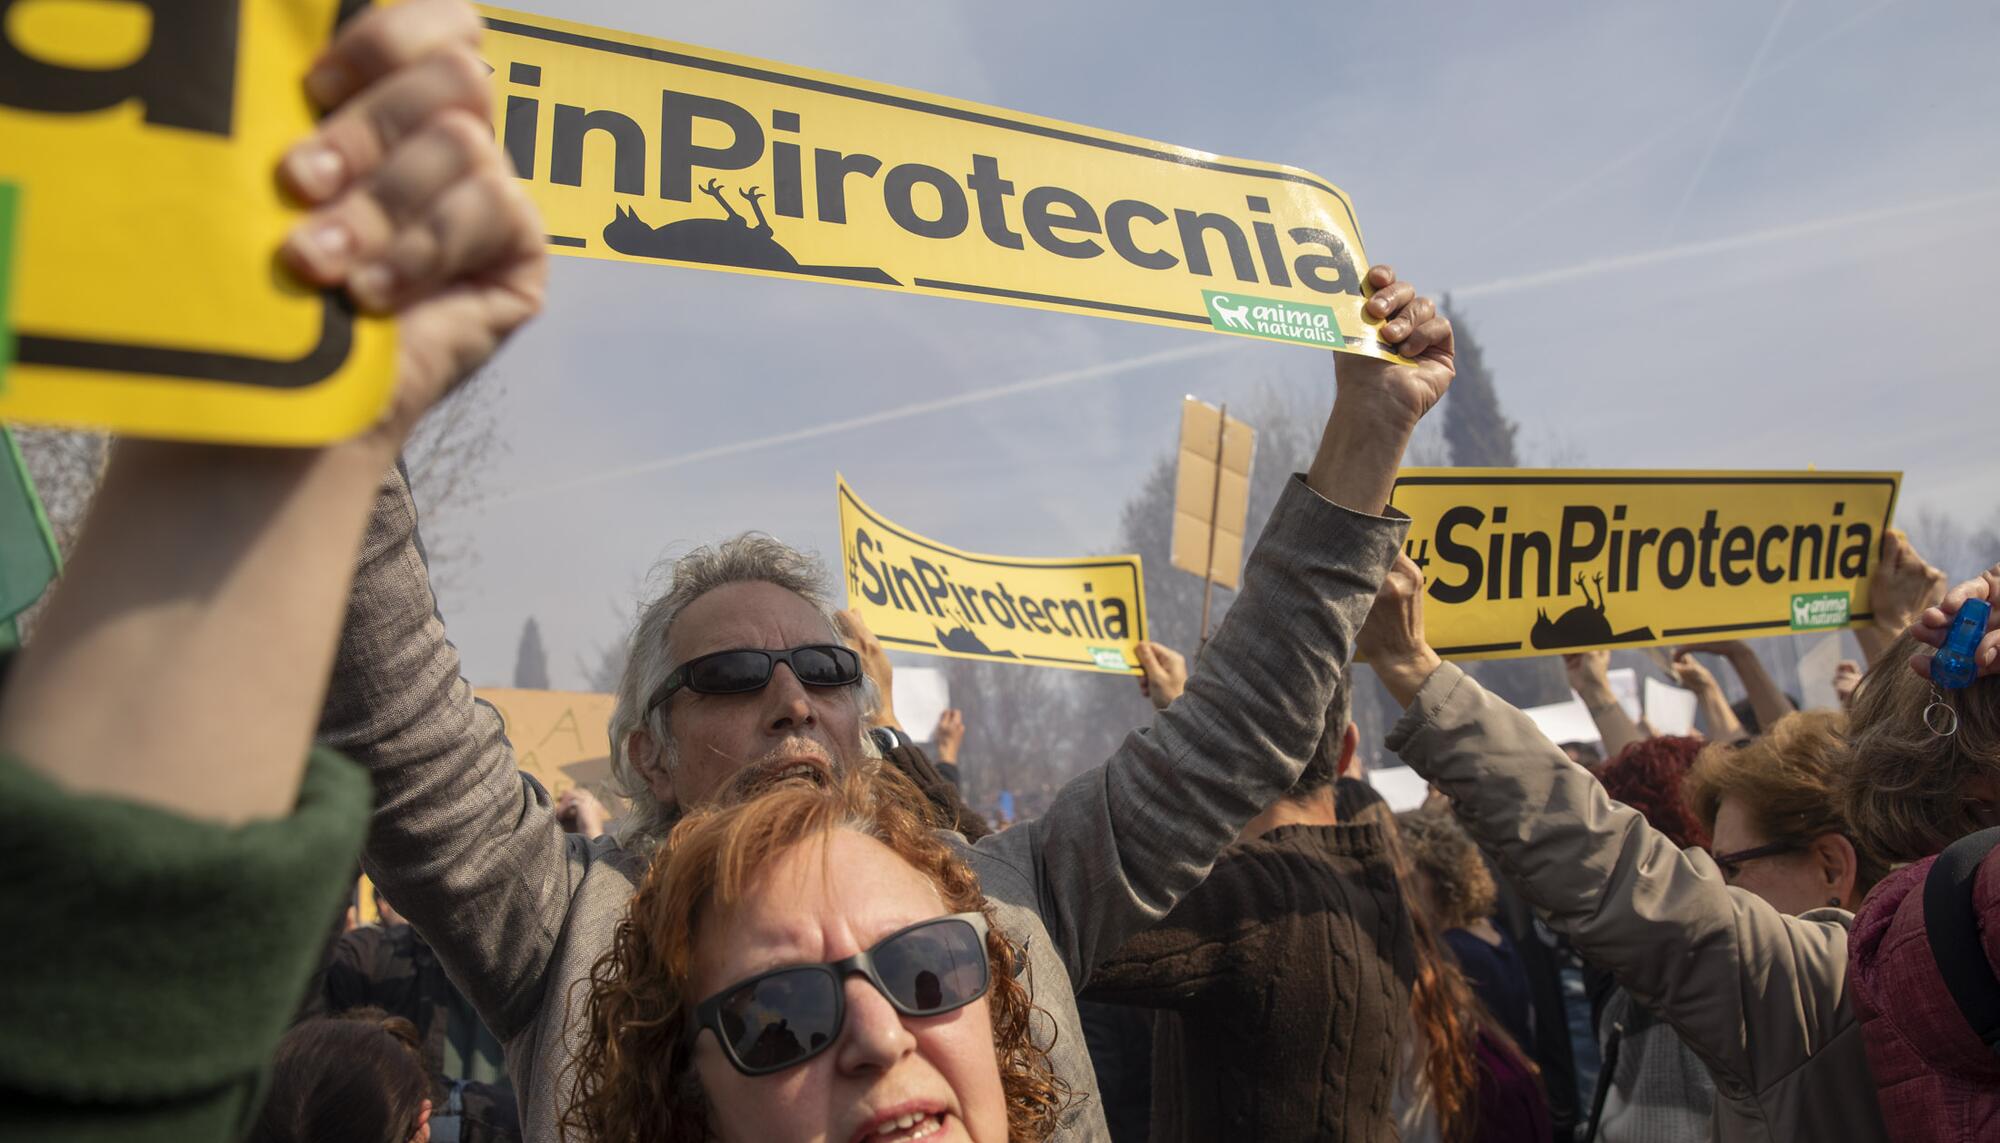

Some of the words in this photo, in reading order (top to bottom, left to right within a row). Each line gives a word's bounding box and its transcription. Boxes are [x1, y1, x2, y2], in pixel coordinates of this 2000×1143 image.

[488, 61, 1362, 297] inPirotecnia
[1251, 304, 1330, 329] anima
[1256, 321, 1336, 343] naturalis
[849, 527, 1130, 641] #SinPirotecnia
